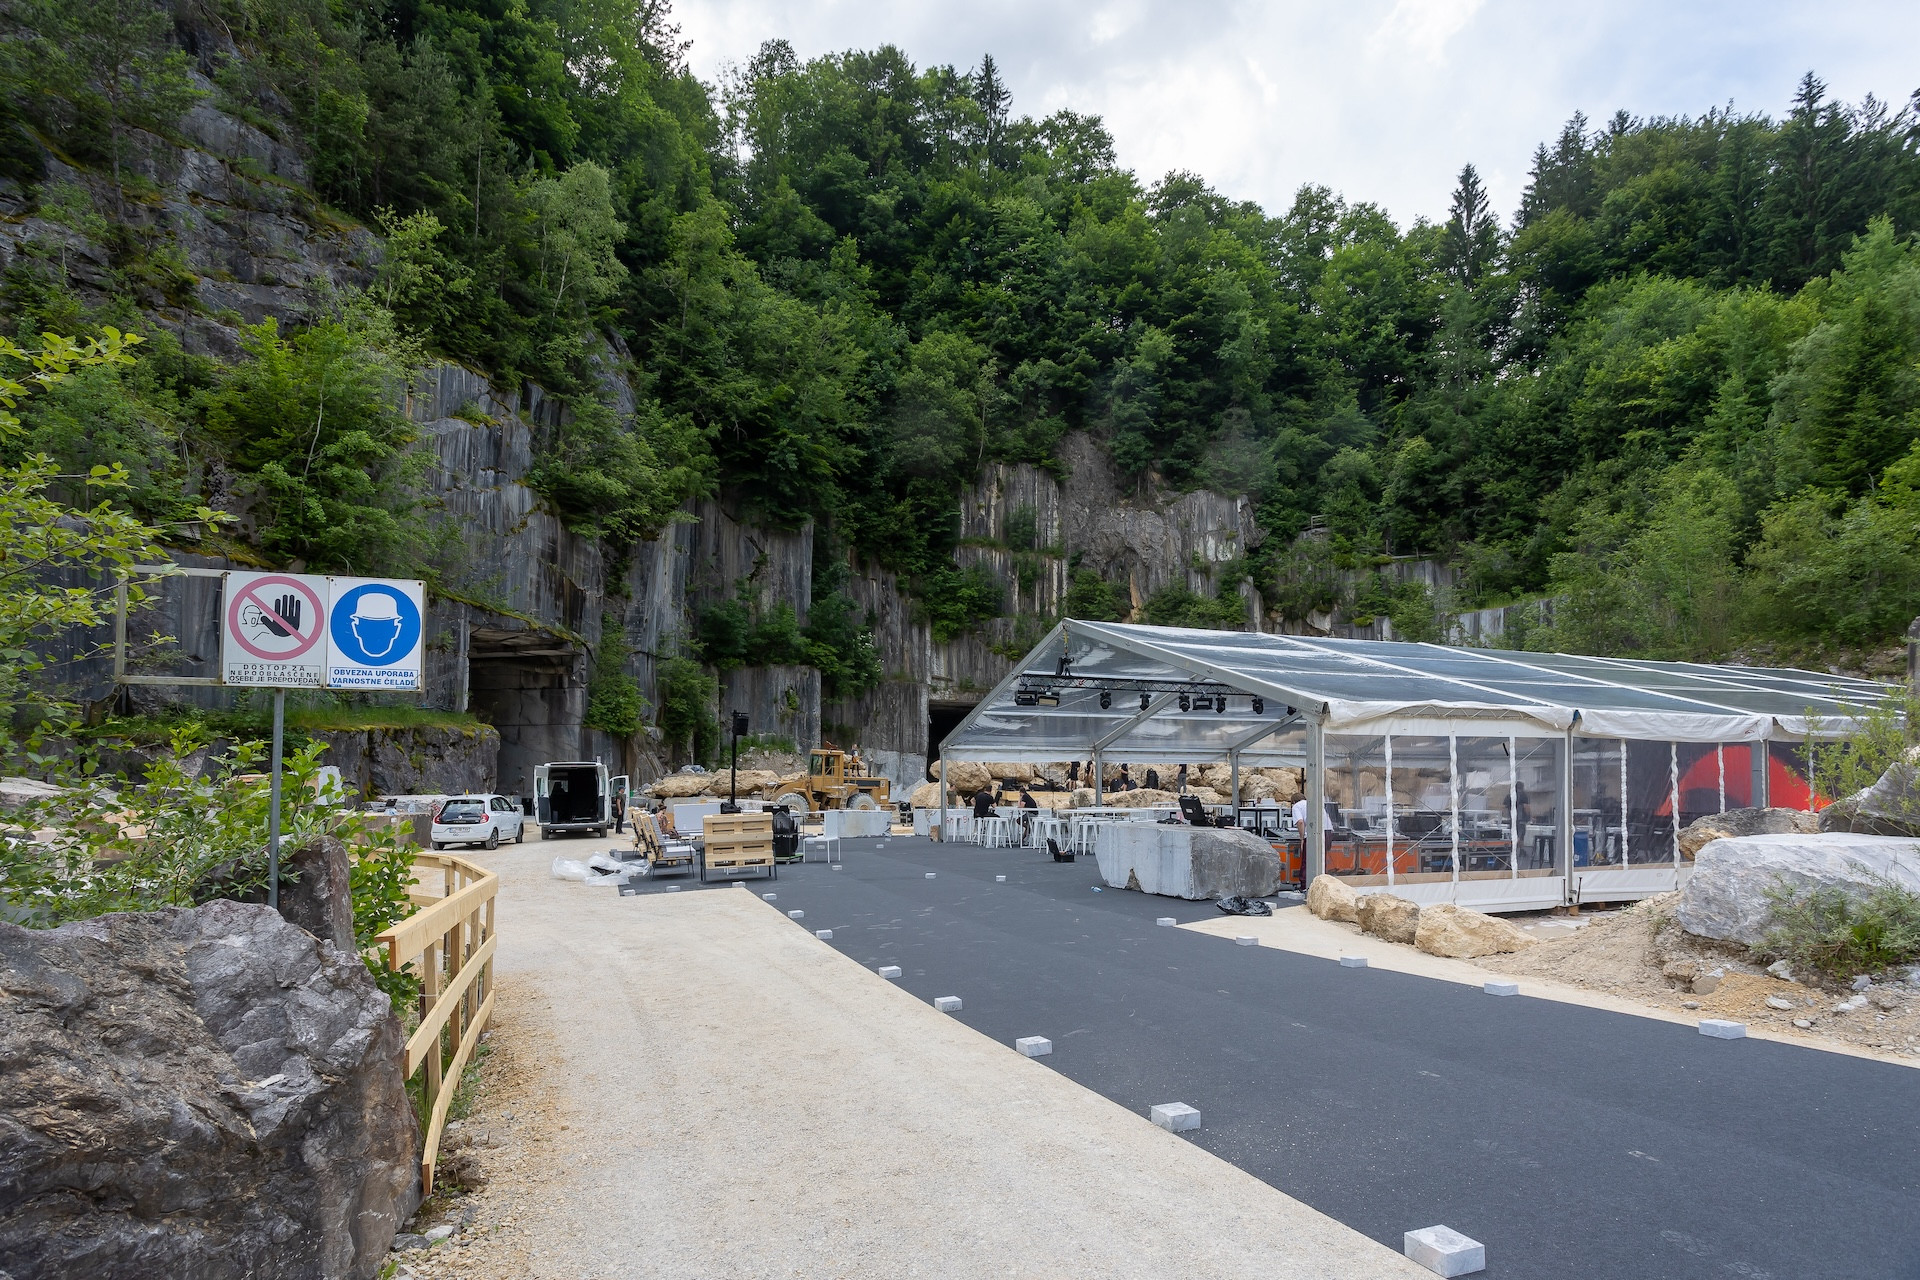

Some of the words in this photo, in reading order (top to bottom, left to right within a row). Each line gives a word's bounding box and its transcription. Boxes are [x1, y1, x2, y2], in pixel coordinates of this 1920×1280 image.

[267, 676, 320, 684] PREPOVEDAN
[332, 677, 382, 685] VARNOSTNE
[384, 677, 416, 686] ČELADE
